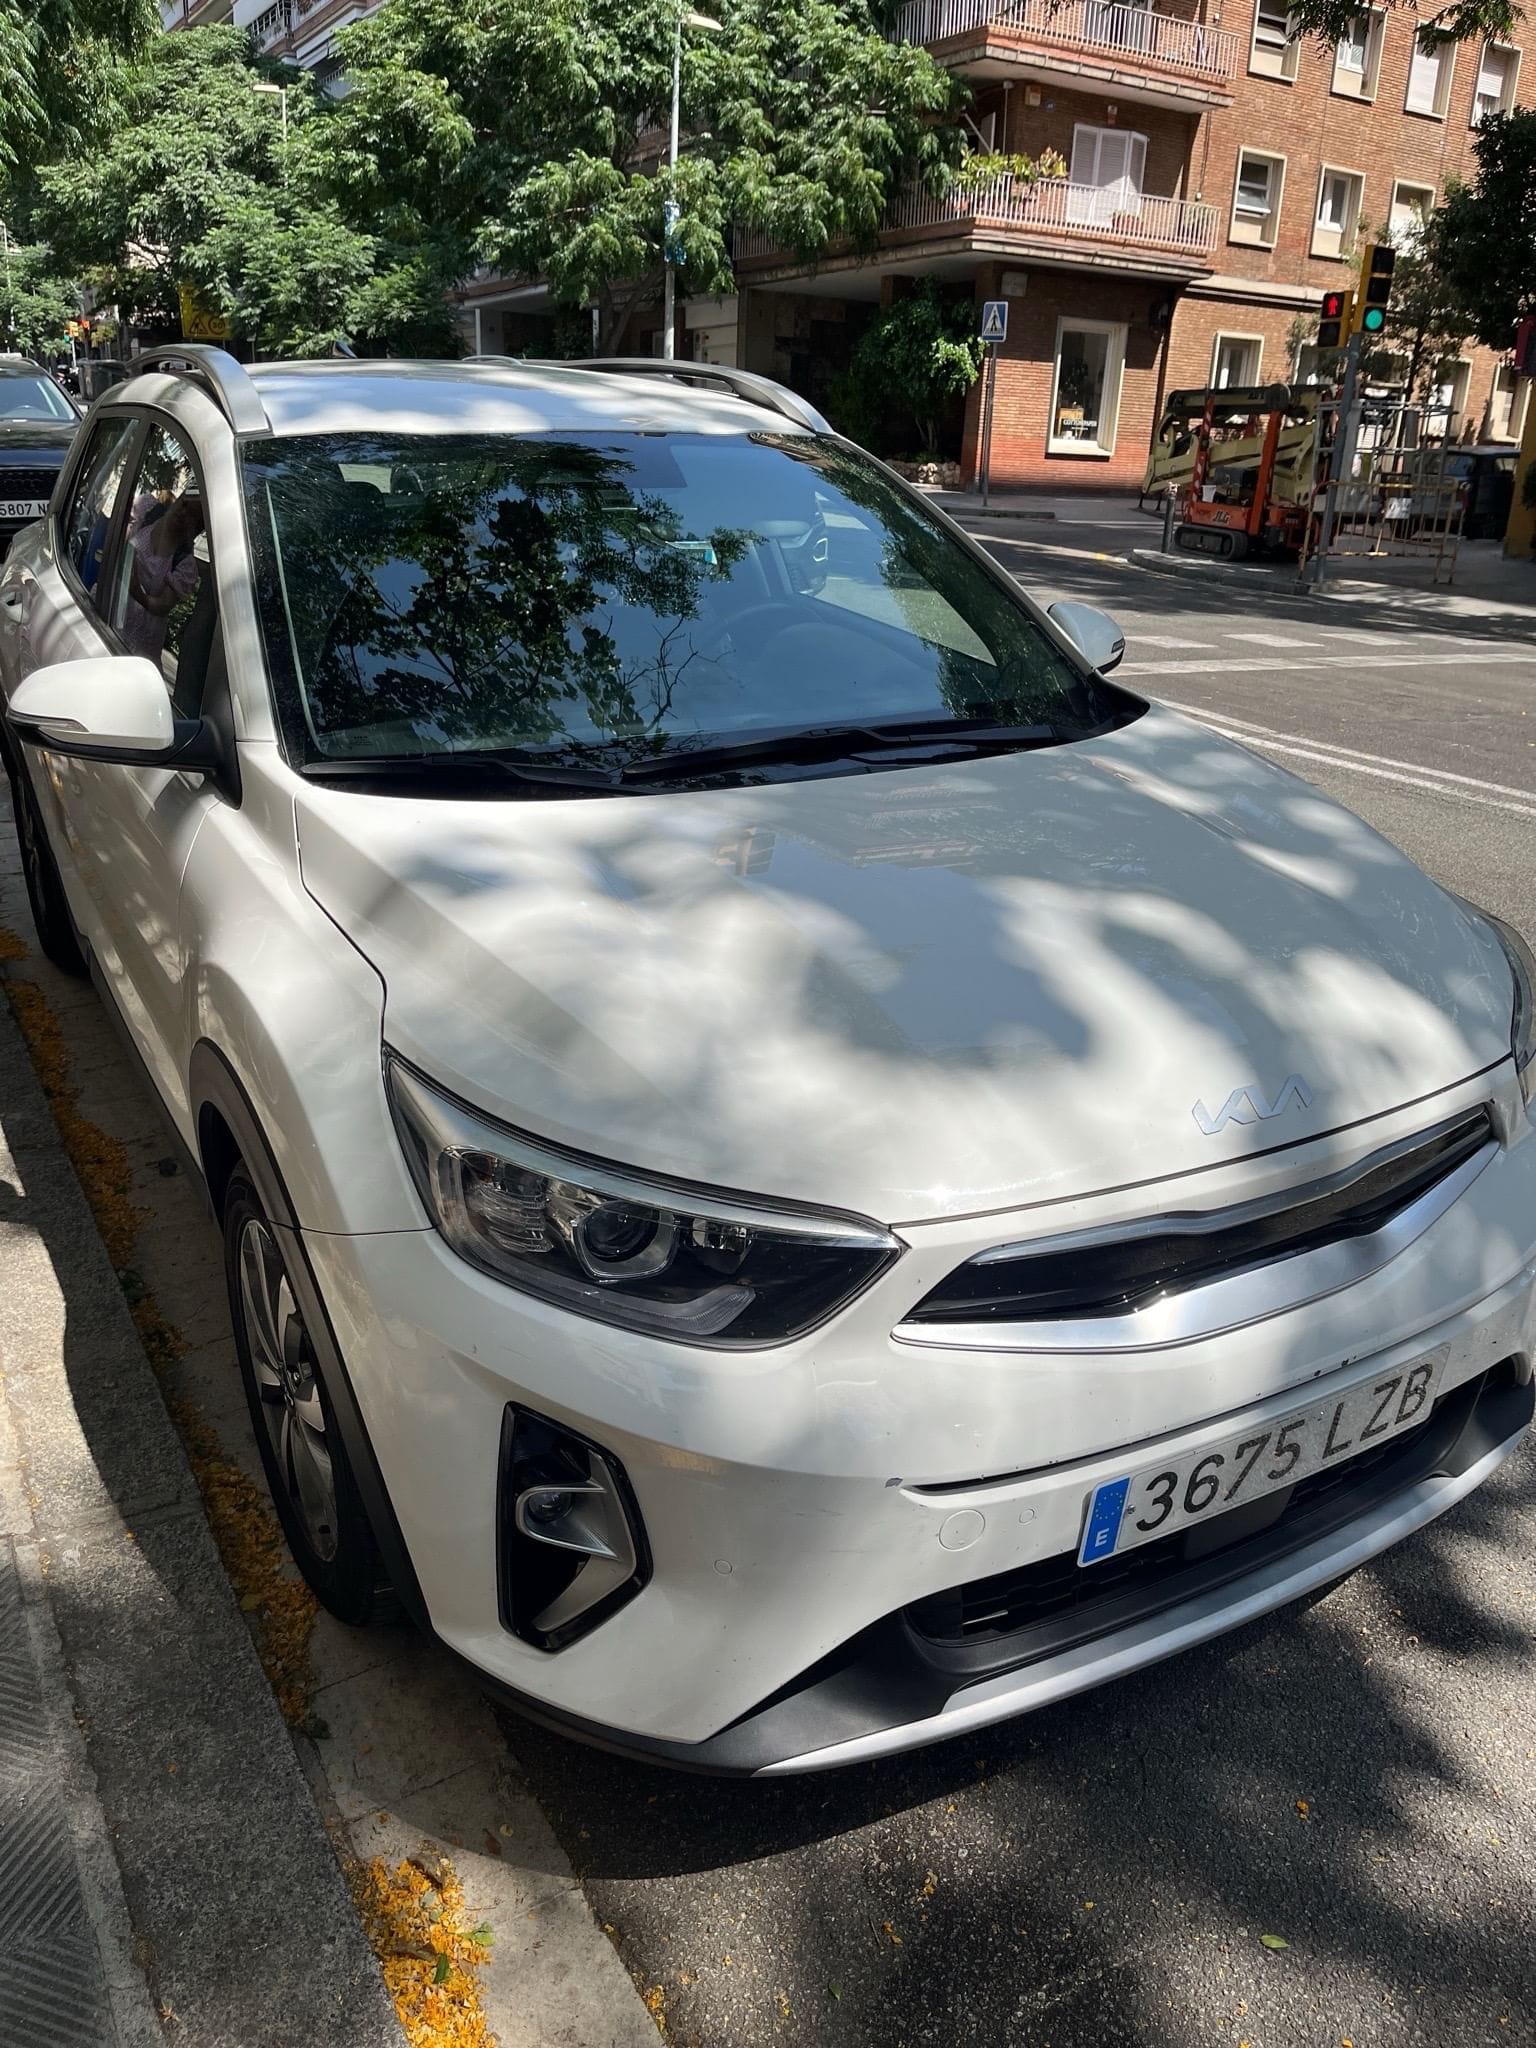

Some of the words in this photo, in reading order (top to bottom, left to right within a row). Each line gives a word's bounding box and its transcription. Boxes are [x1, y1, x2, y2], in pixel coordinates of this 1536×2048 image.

[0, 503, 32, 516] 5807
[37, 503, 50, 516] N
[1191, 1072, 1313, 1136] KIA
[1135, 1419, 1305, 1532] 3675
[1322, 1361, 1434, 1460] LZB
[1094, 1527, 1108, 1547] E
